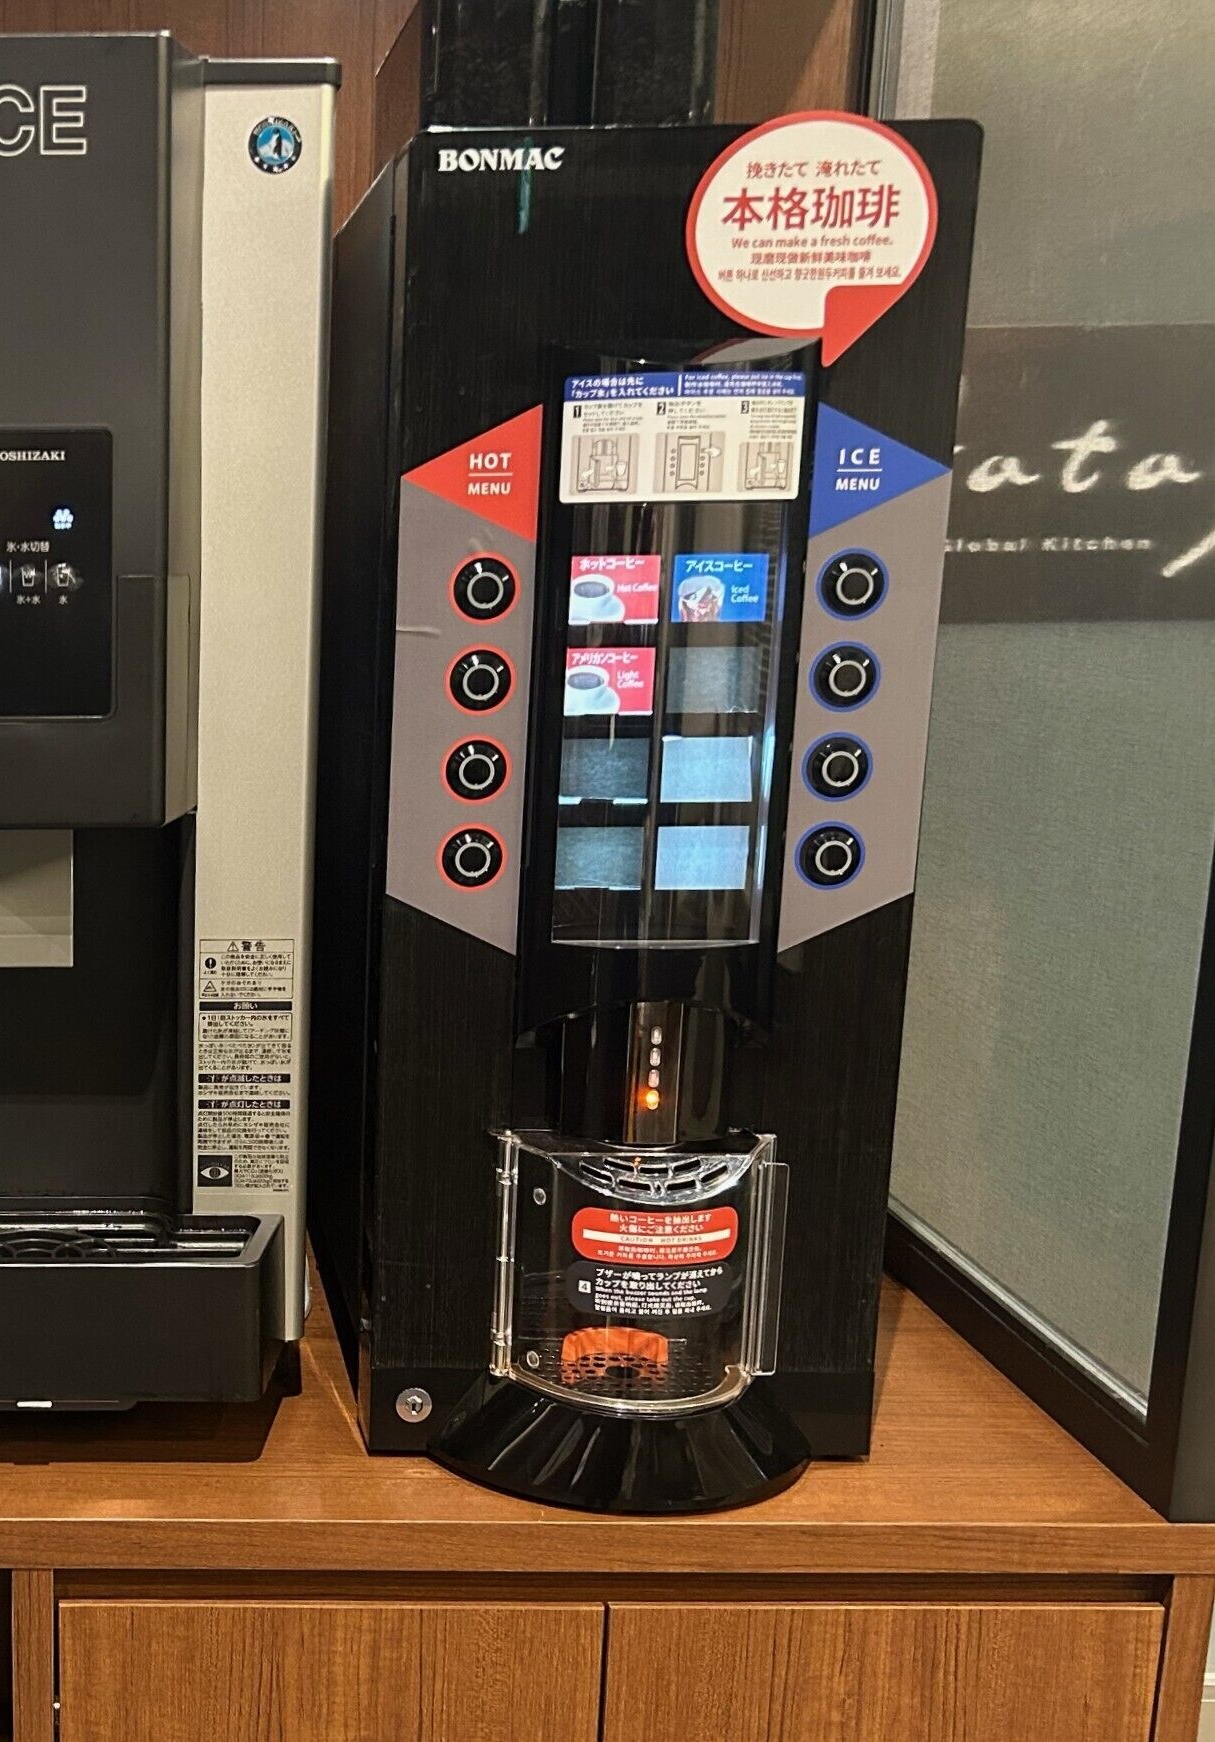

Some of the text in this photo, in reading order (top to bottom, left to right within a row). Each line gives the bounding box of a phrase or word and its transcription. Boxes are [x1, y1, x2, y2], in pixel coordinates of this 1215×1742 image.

[438, 146, 565, 172] BONMAC
[746, 160, 809, 179] 挽きたて
[721, 184, 901, 232] 本格珈琲
[731, 234, 894, 249] We can make a fresh coffee.
[657, 402, 666, 415] 2
[741, 401, 750, 414] 3
[469, 452, 513, 470] HOT
[838, 447, 881, 465] ICE
[953, 419, 1202, 493] ata
[467, 482, 511, 496] MENU
[834, 477, 881, 491] MENU
[1041, 536, 1153, 552] Kitchen
[578, 556, 645, 571] ホットコーヒー
[686, 560, 753, 572] アイスコーヒー
[616, 582, 658, 593] Hot Coffee
[731, 584, 749, 593] Iced
[58, 595, 68, 605] 水
[730, 593, 759, 604] Coffee
[571, 652, 638, 666] アメリカンコーヒー
[617, 671, 639, 682] Light
[616, 679, 644, 689] Coffee
[241, 940, 266, 952] 警告
[233, 1002, 258, 1010] お願い
[609, 1213, 712, 1225] 熱いコーヒーを抽出します
[619, 1224, 704, 1235] 火傷にご注意ください
[595, 1266, 723, 1281] ブザーが鳴ってランプが消えてから
[581, 1282, 589, 1291] 4
[595, 1278, 701, 1291] カップを取り出してください
